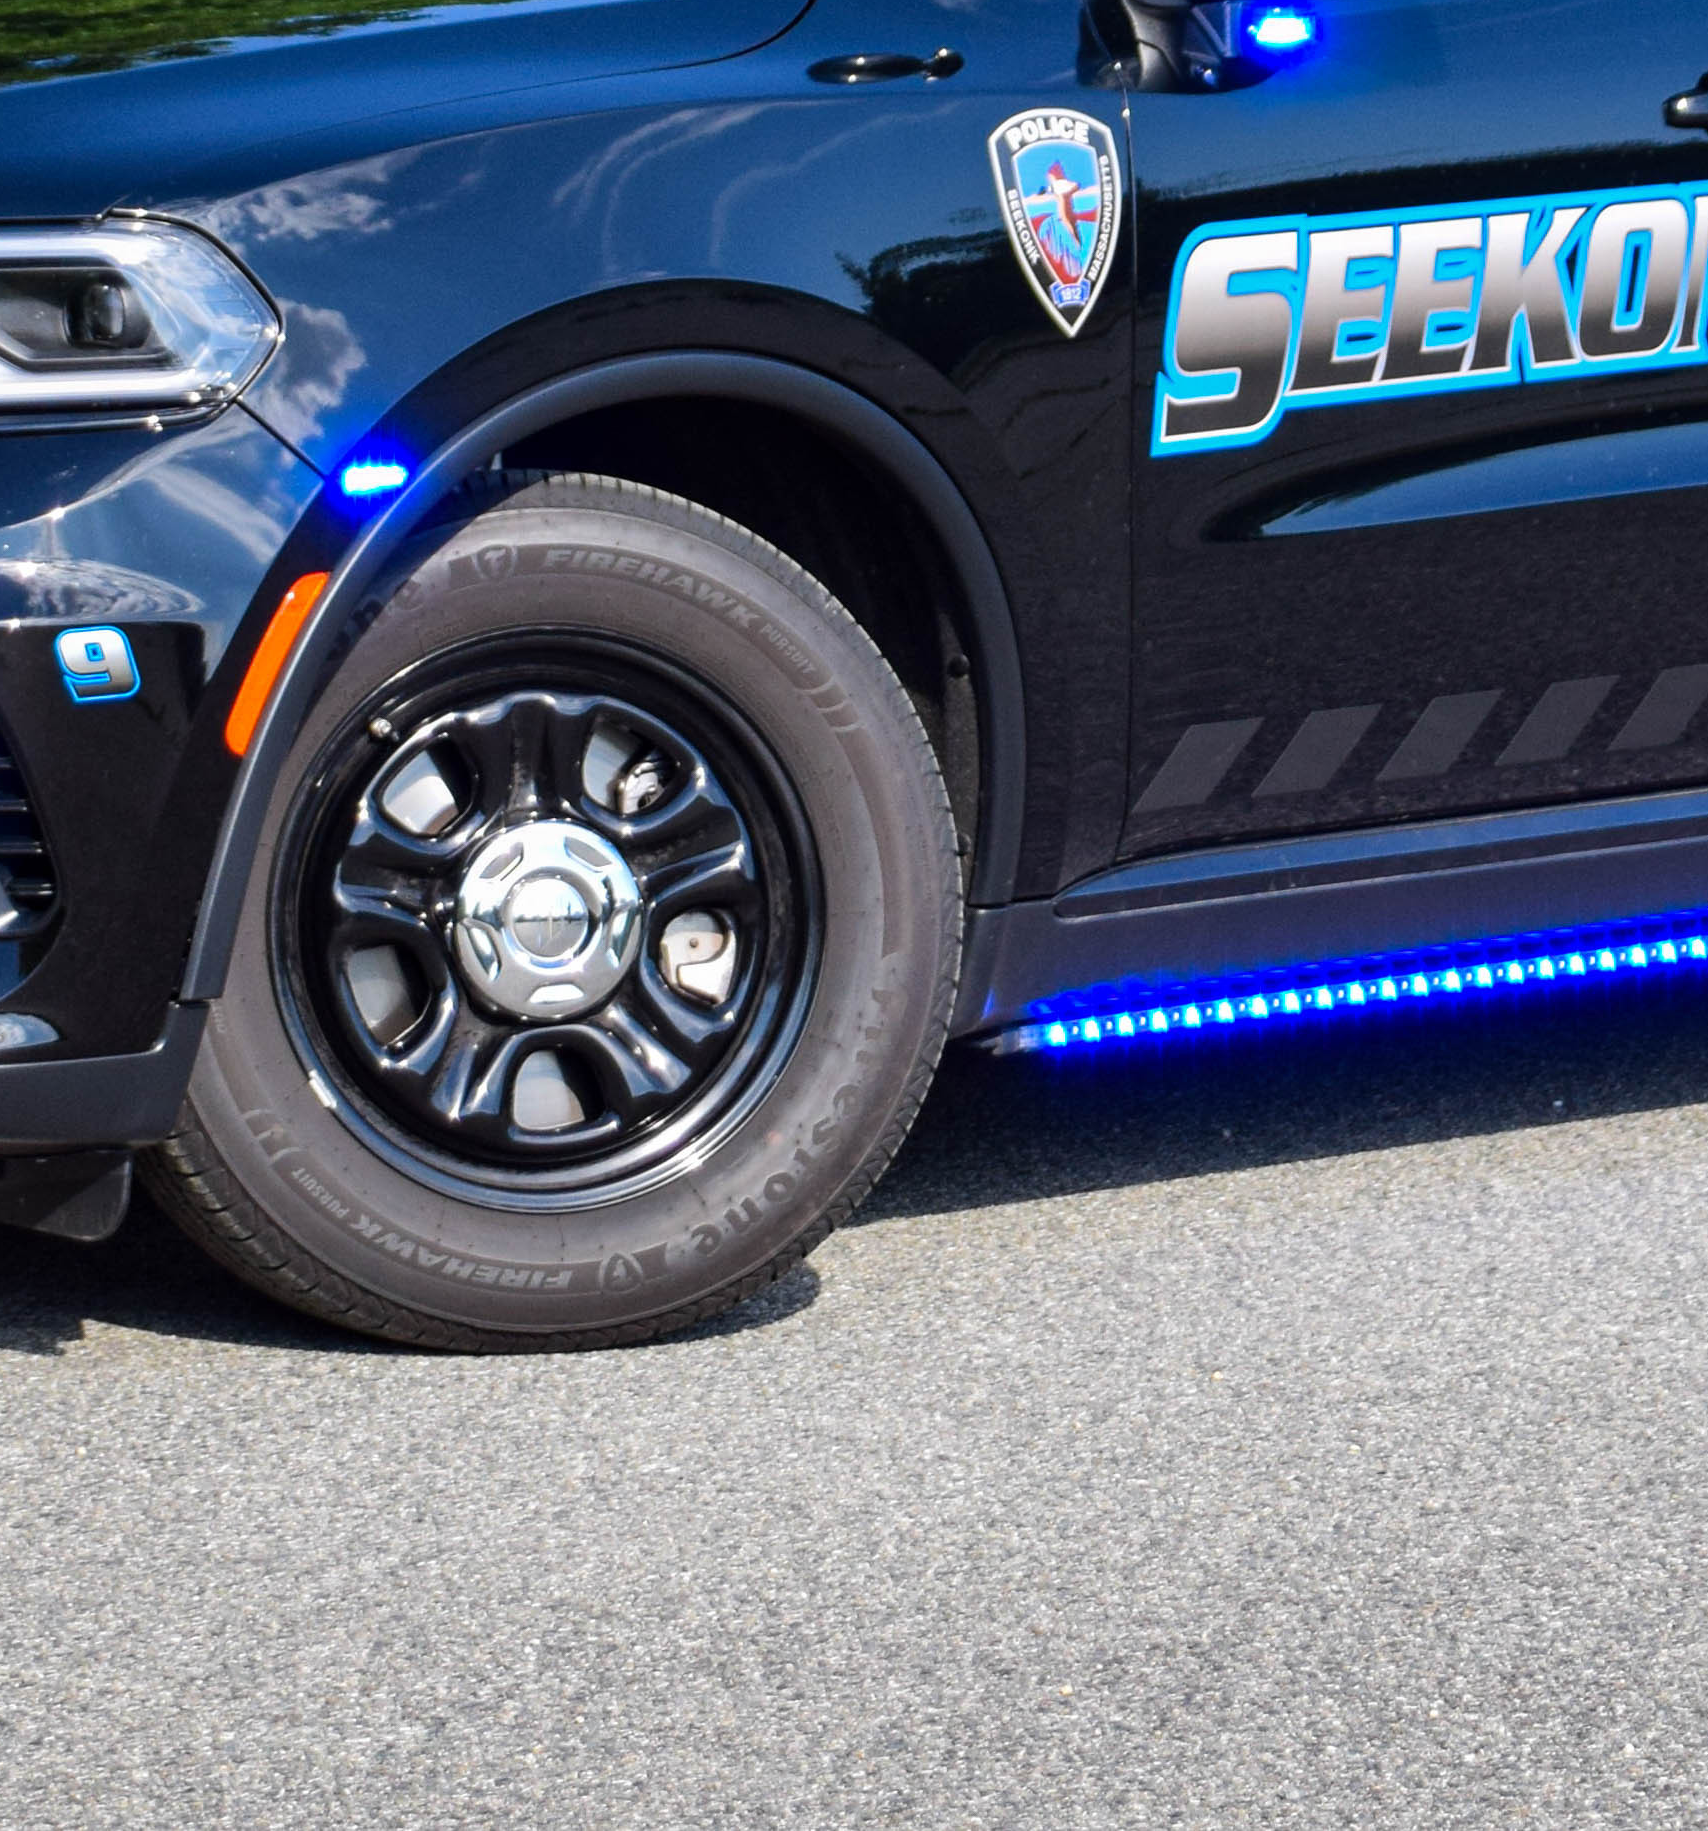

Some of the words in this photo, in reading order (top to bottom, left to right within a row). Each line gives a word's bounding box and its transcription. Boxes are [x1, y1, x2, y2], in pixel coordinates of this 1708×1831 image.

[1005, 116, 1089, 151] POLICE
[1008, 189, 1041, 266] SEEKONK
[1088, 155, 1114, 282] MASSACHUSETTS
[543, 547, 762, 628] FIREHAWK
[760, 623, 817, 674] PURSUIT
[55, 625, 141, 702] 9
[290, 1167, 351, 1219] PURSUIT
[350, 1214, 574, 1289] FIREHAWK
